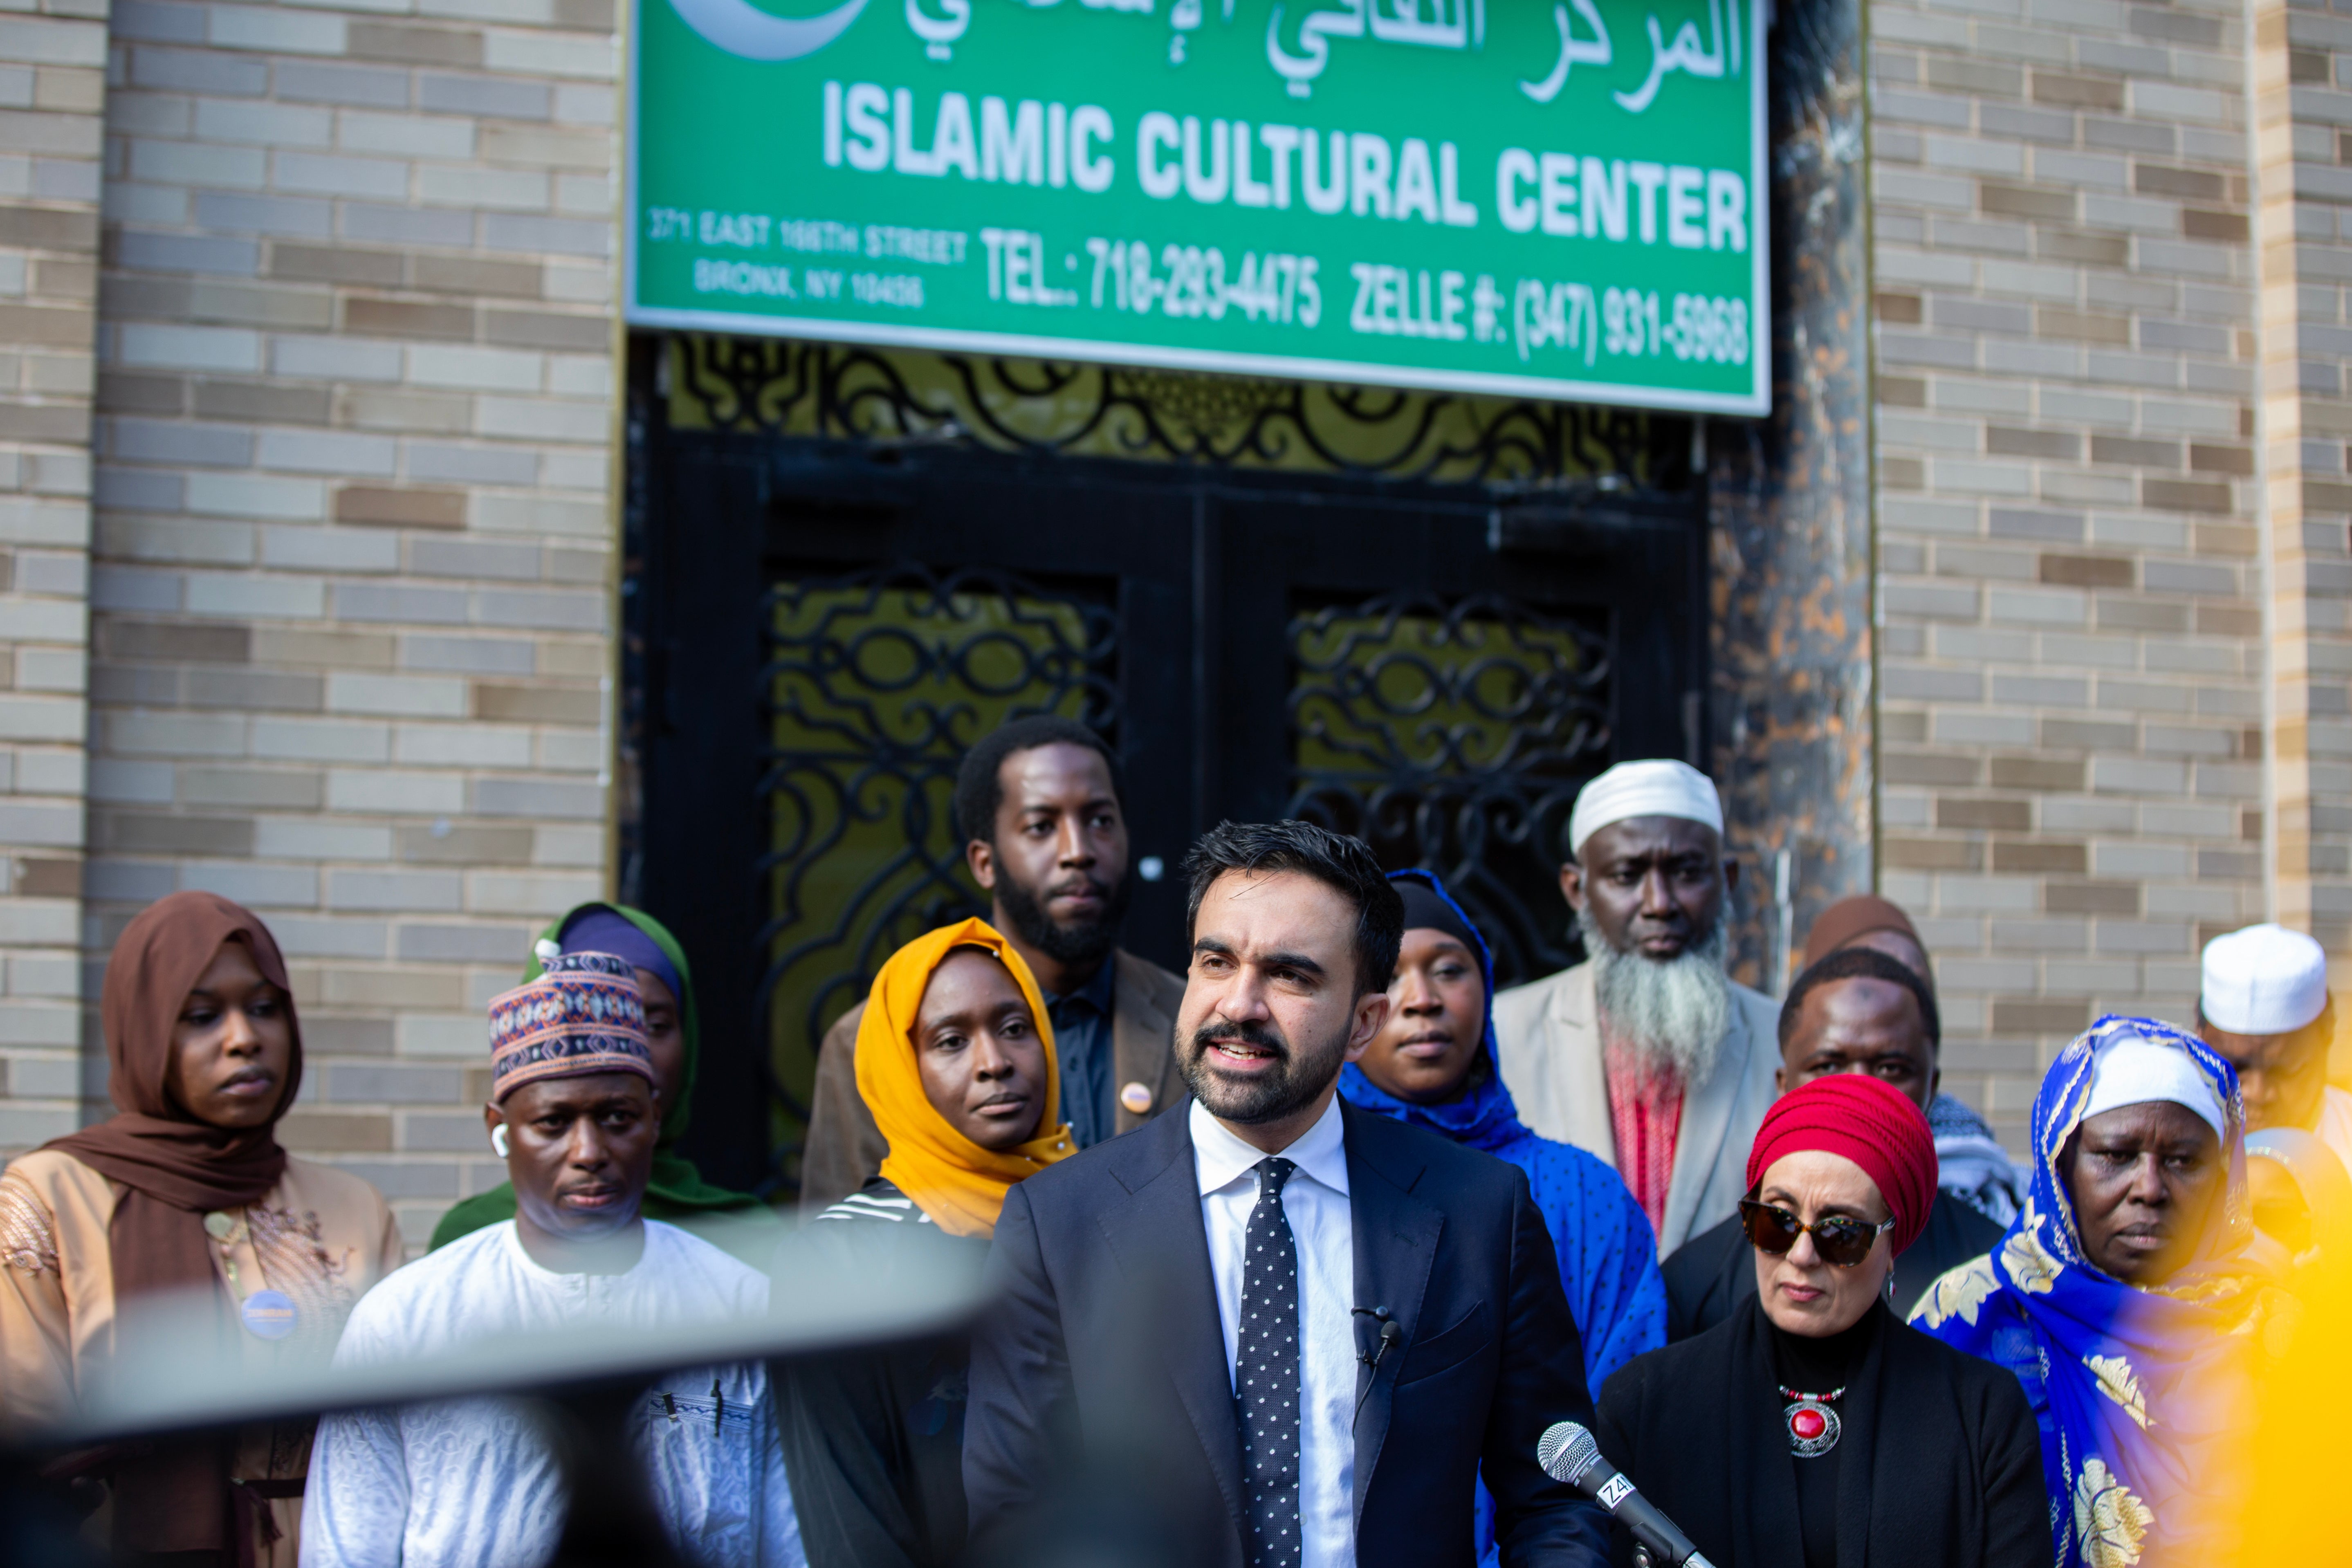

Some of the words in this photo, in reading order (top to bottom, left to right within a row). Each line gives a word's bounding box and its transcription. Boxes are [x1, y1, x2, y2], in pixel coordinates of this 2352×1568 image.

[824, 81, 1115, 193] ISLAMIC
[1136, 111, 1478, 227] CULTURAL
[1496, 147, 1747, 253] CENTER
[695, 258, 797, 299] BRONX,
[806, 269, 843, 298] NY
[700, 211, 770, 247] EAST
[864, 224, 968, 265] STREET
[1086, 237, 1322, 328] 718-293-4475
[1350, 262, 1467, 341] ZELLE
[1514, 278, 1598, 367] (347)
[1603, 286, 1749, 365] 931-5968
